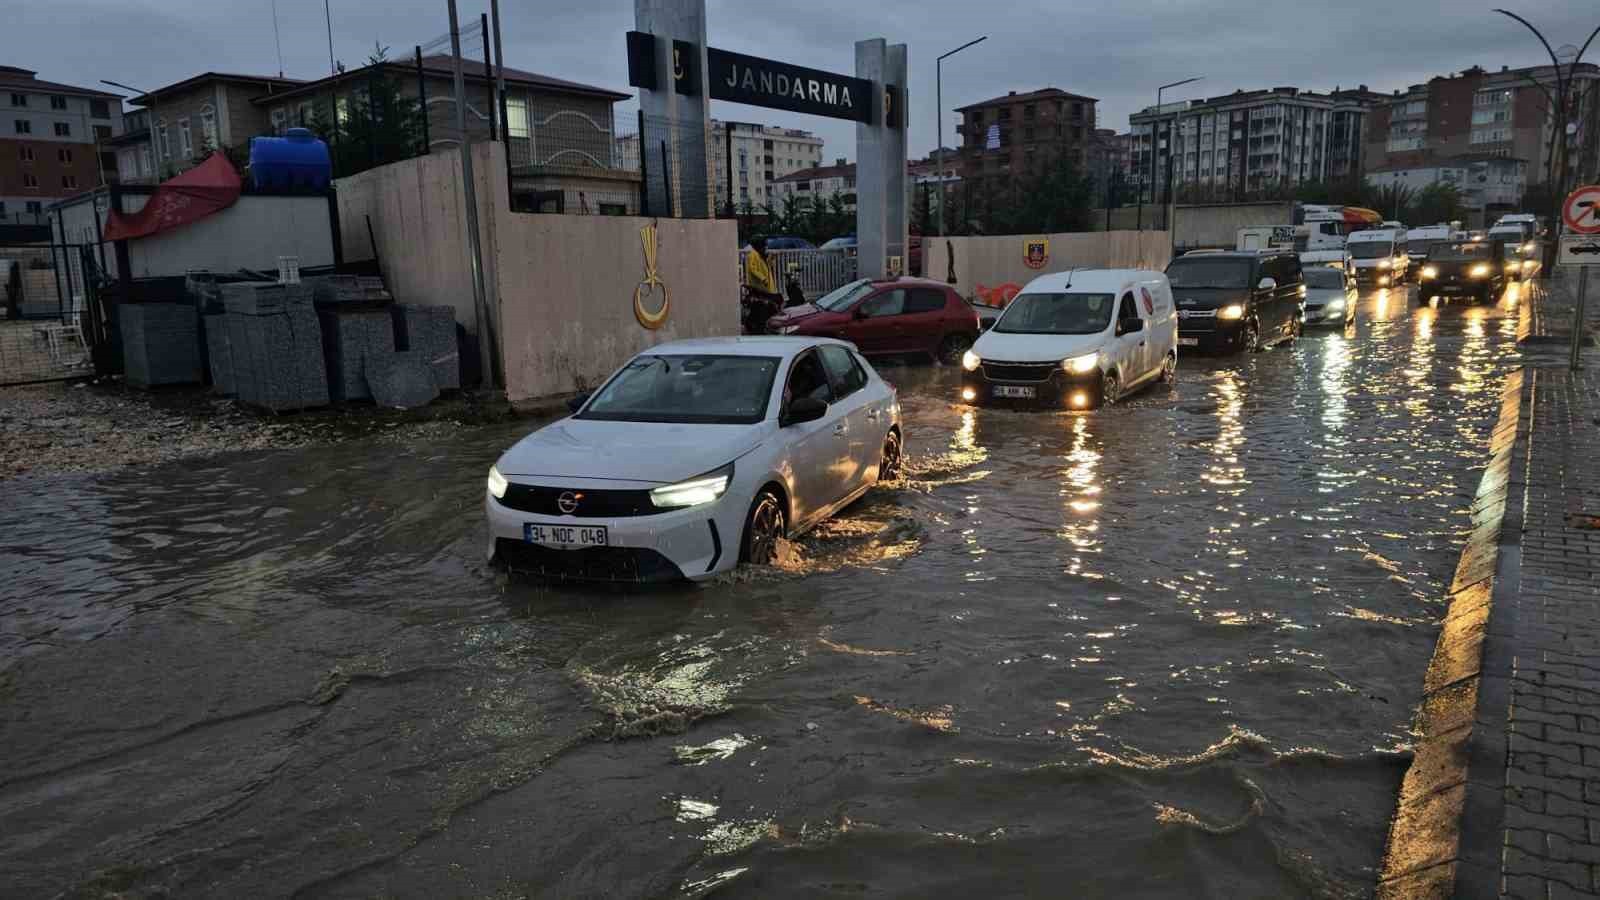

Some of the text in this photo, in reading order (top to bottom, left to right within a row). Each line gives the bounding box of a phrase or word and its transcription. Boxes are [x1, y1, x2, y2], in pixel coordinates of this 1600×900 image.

[727, 64, 852, 107] JANDARMA
[532, 526, 604, 544] 34 NOC 048
